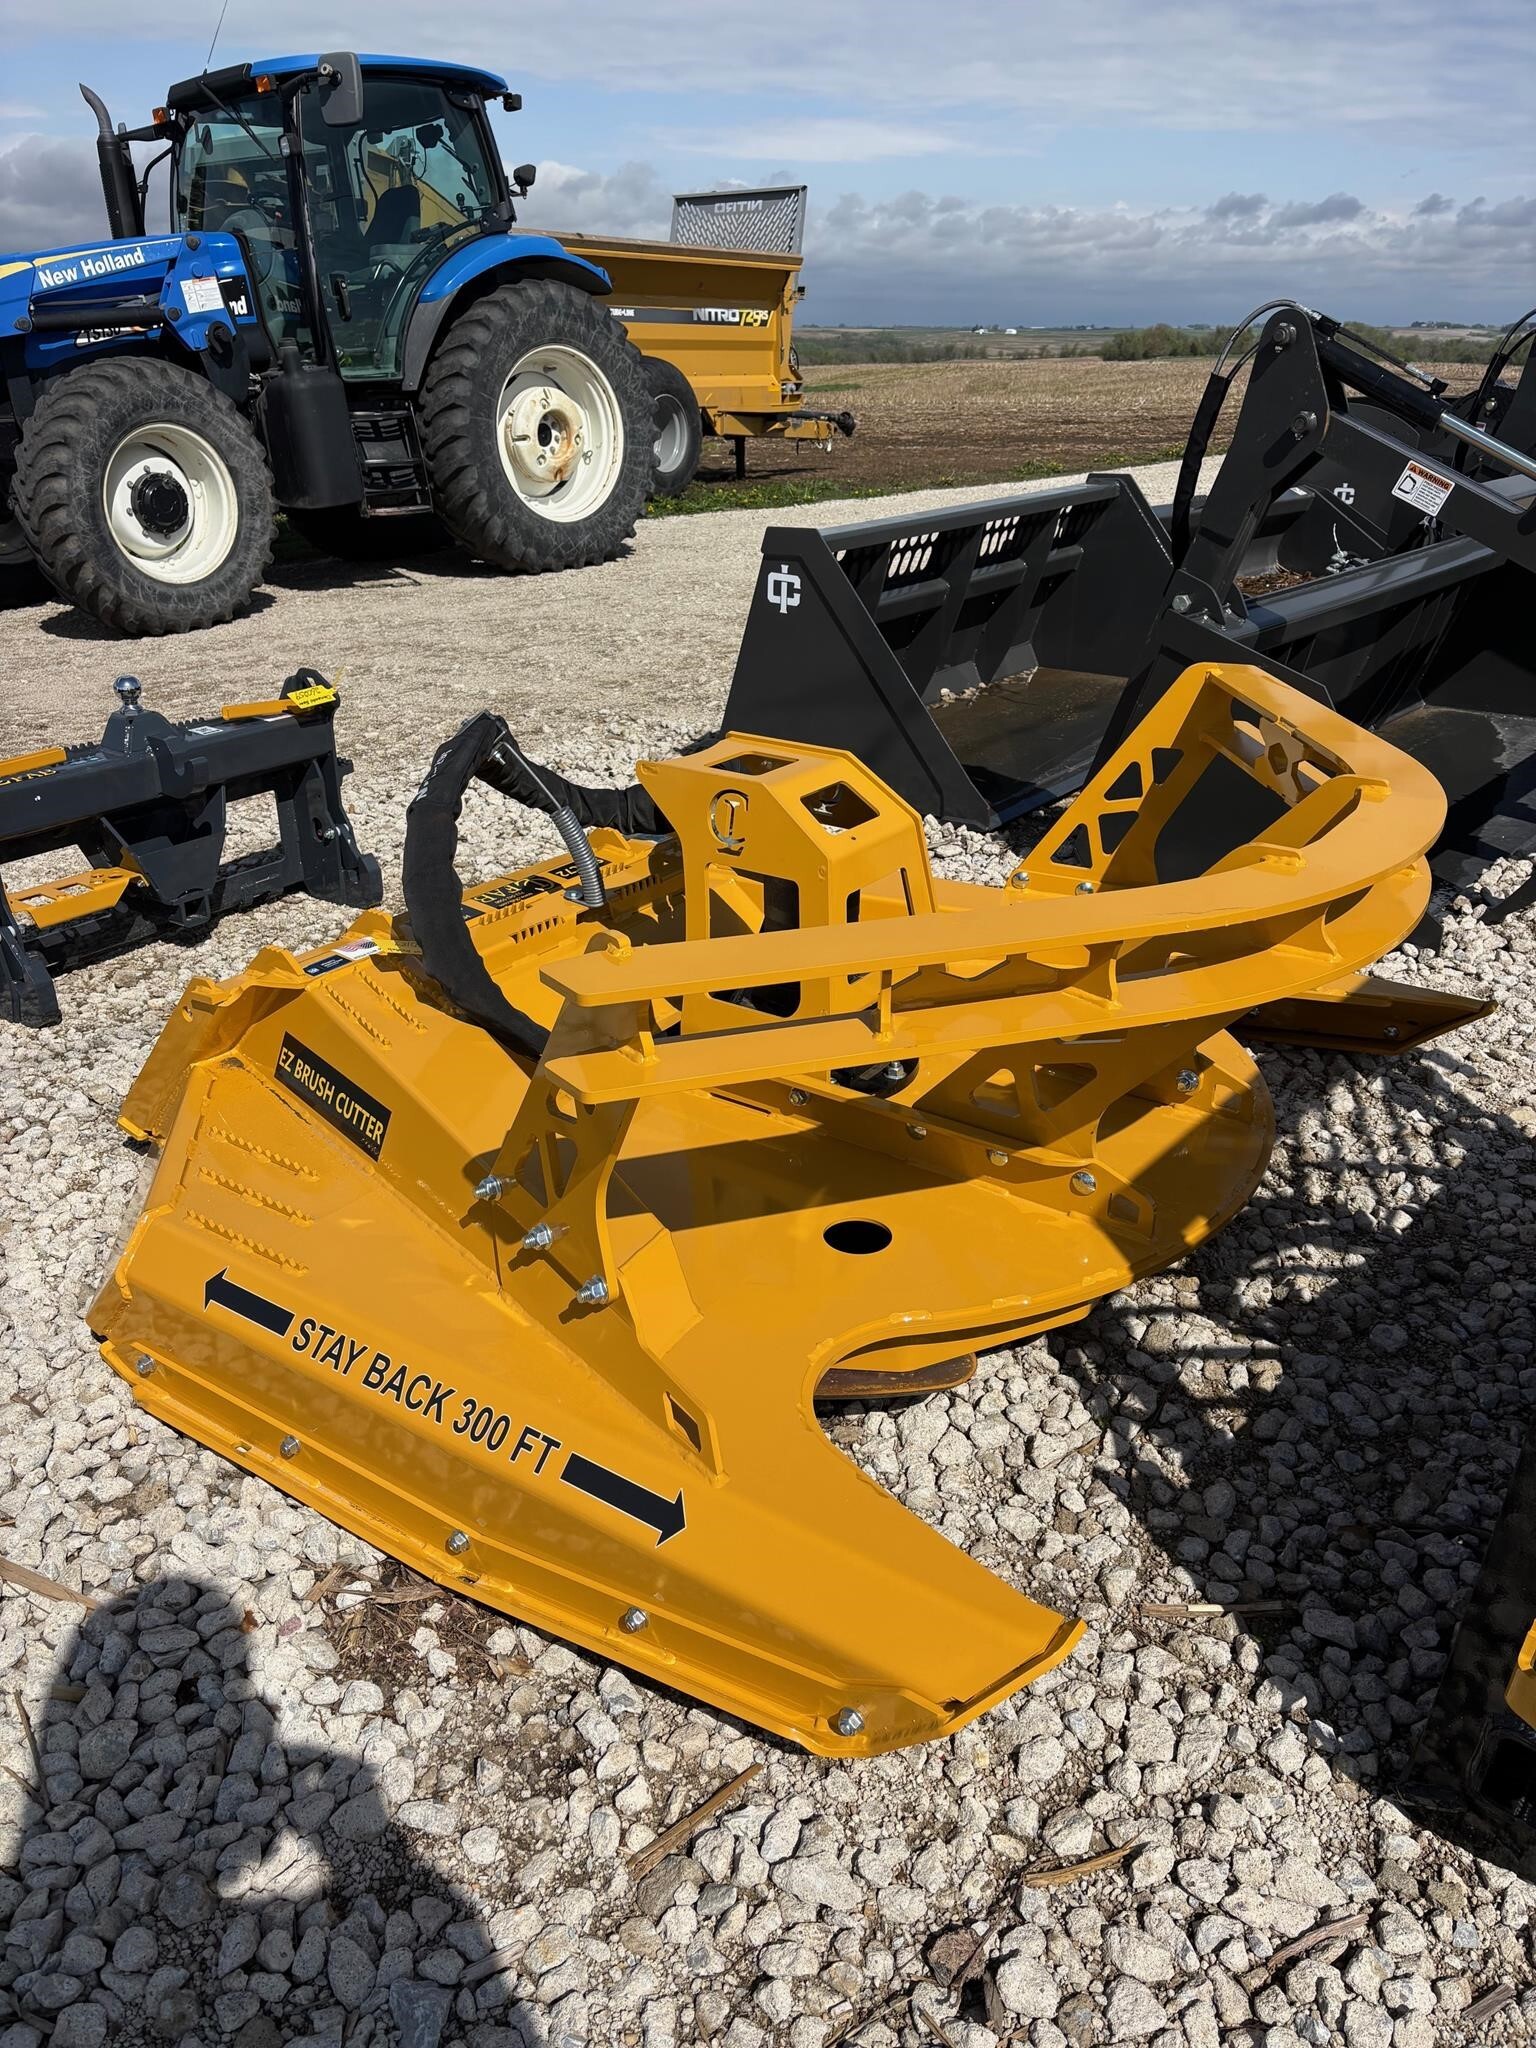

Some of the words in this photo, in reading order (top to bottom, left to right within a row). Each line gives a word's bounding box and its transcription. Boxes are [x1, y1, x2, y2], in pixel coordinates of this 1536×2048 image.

[38, 268, 78, 289] New
[80, 246, 145, 278] Holland
[692, 307, 740, 322] NITRO
[1418, 468, 1452, 490] WARNING
[279, 1046, 295, 1073] EZ
[294, 1058, 335, 1105] BRUSH
[335, 1092, 384, 1145] CUTTER
[292, 1318, 368, 1376] STAY
[361, 1352, 456, 1424] BACK
[453, 1398, 511, 1452] 300
[509, 1424, 562, 1476] FT
